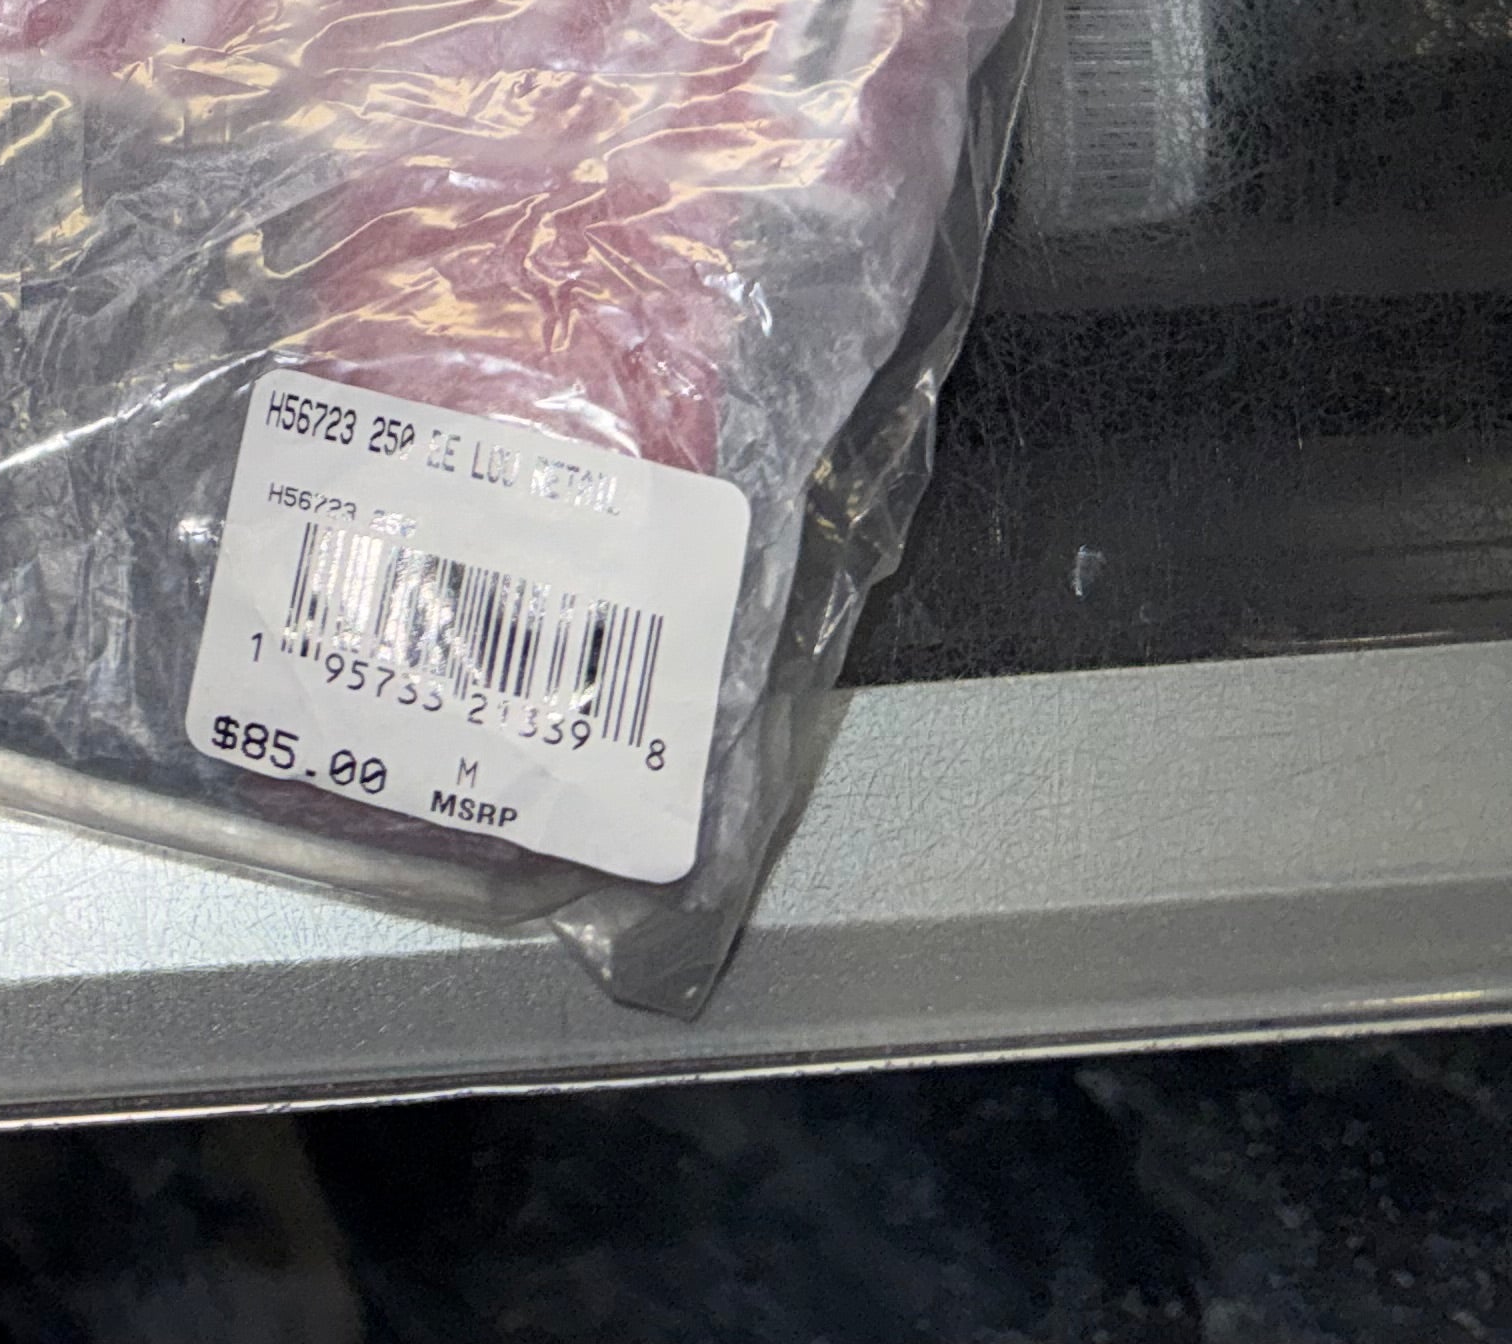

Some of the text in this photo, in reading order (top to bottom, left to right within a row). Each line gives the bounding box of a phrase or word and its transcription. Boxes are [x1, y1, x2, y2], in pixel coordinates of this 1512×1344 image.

[266, 389, 355, 445] H56723
[267, 482, 356, 521] H56723
[250, 632, 666, 772] 1 95733 21339 8
[211, 715, 387, 795] $85.00
[456, 757, 478, 788] M
[430, 790, 518, 828] MSRP
